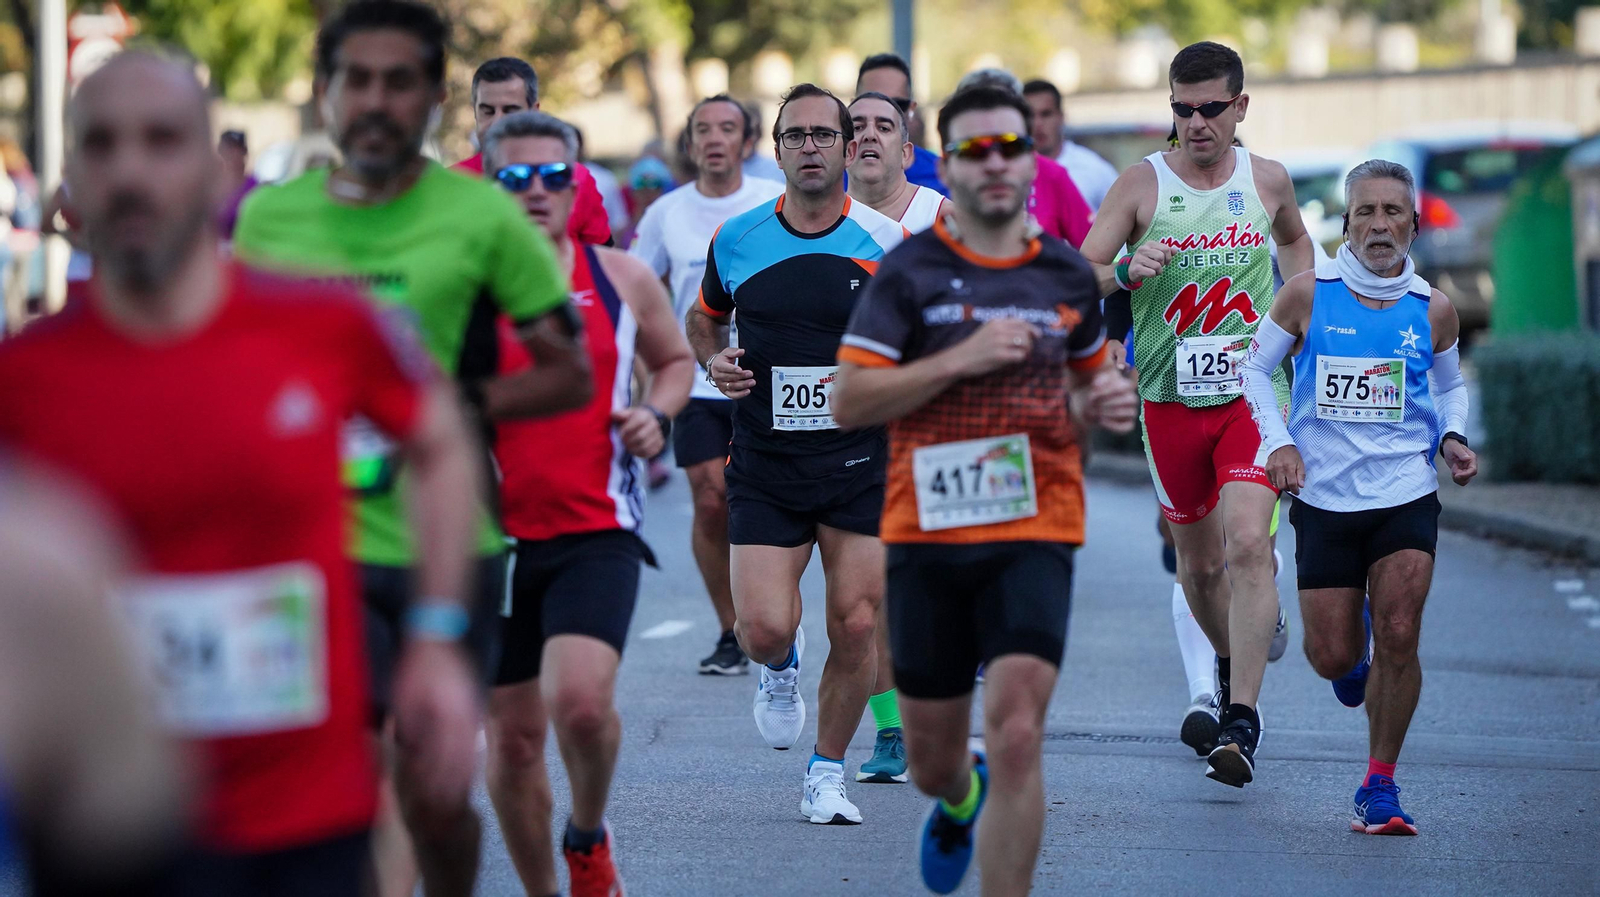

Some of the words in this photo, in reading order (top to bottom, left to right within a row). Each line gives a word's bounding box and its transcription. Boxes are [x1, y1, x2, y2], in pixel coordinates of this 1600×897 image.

[1160, 222, 1265, 251] maratón
[1180, 252, 1249, 268] JEREZ
[1187, 353, 1230, 377] 125
[1364, 365, 1391, 376] MARATÓN
[781, 384, 826, 409] 205
[1325, 374, 1370, 401] 575
[930, 464, 983, 499] 417
